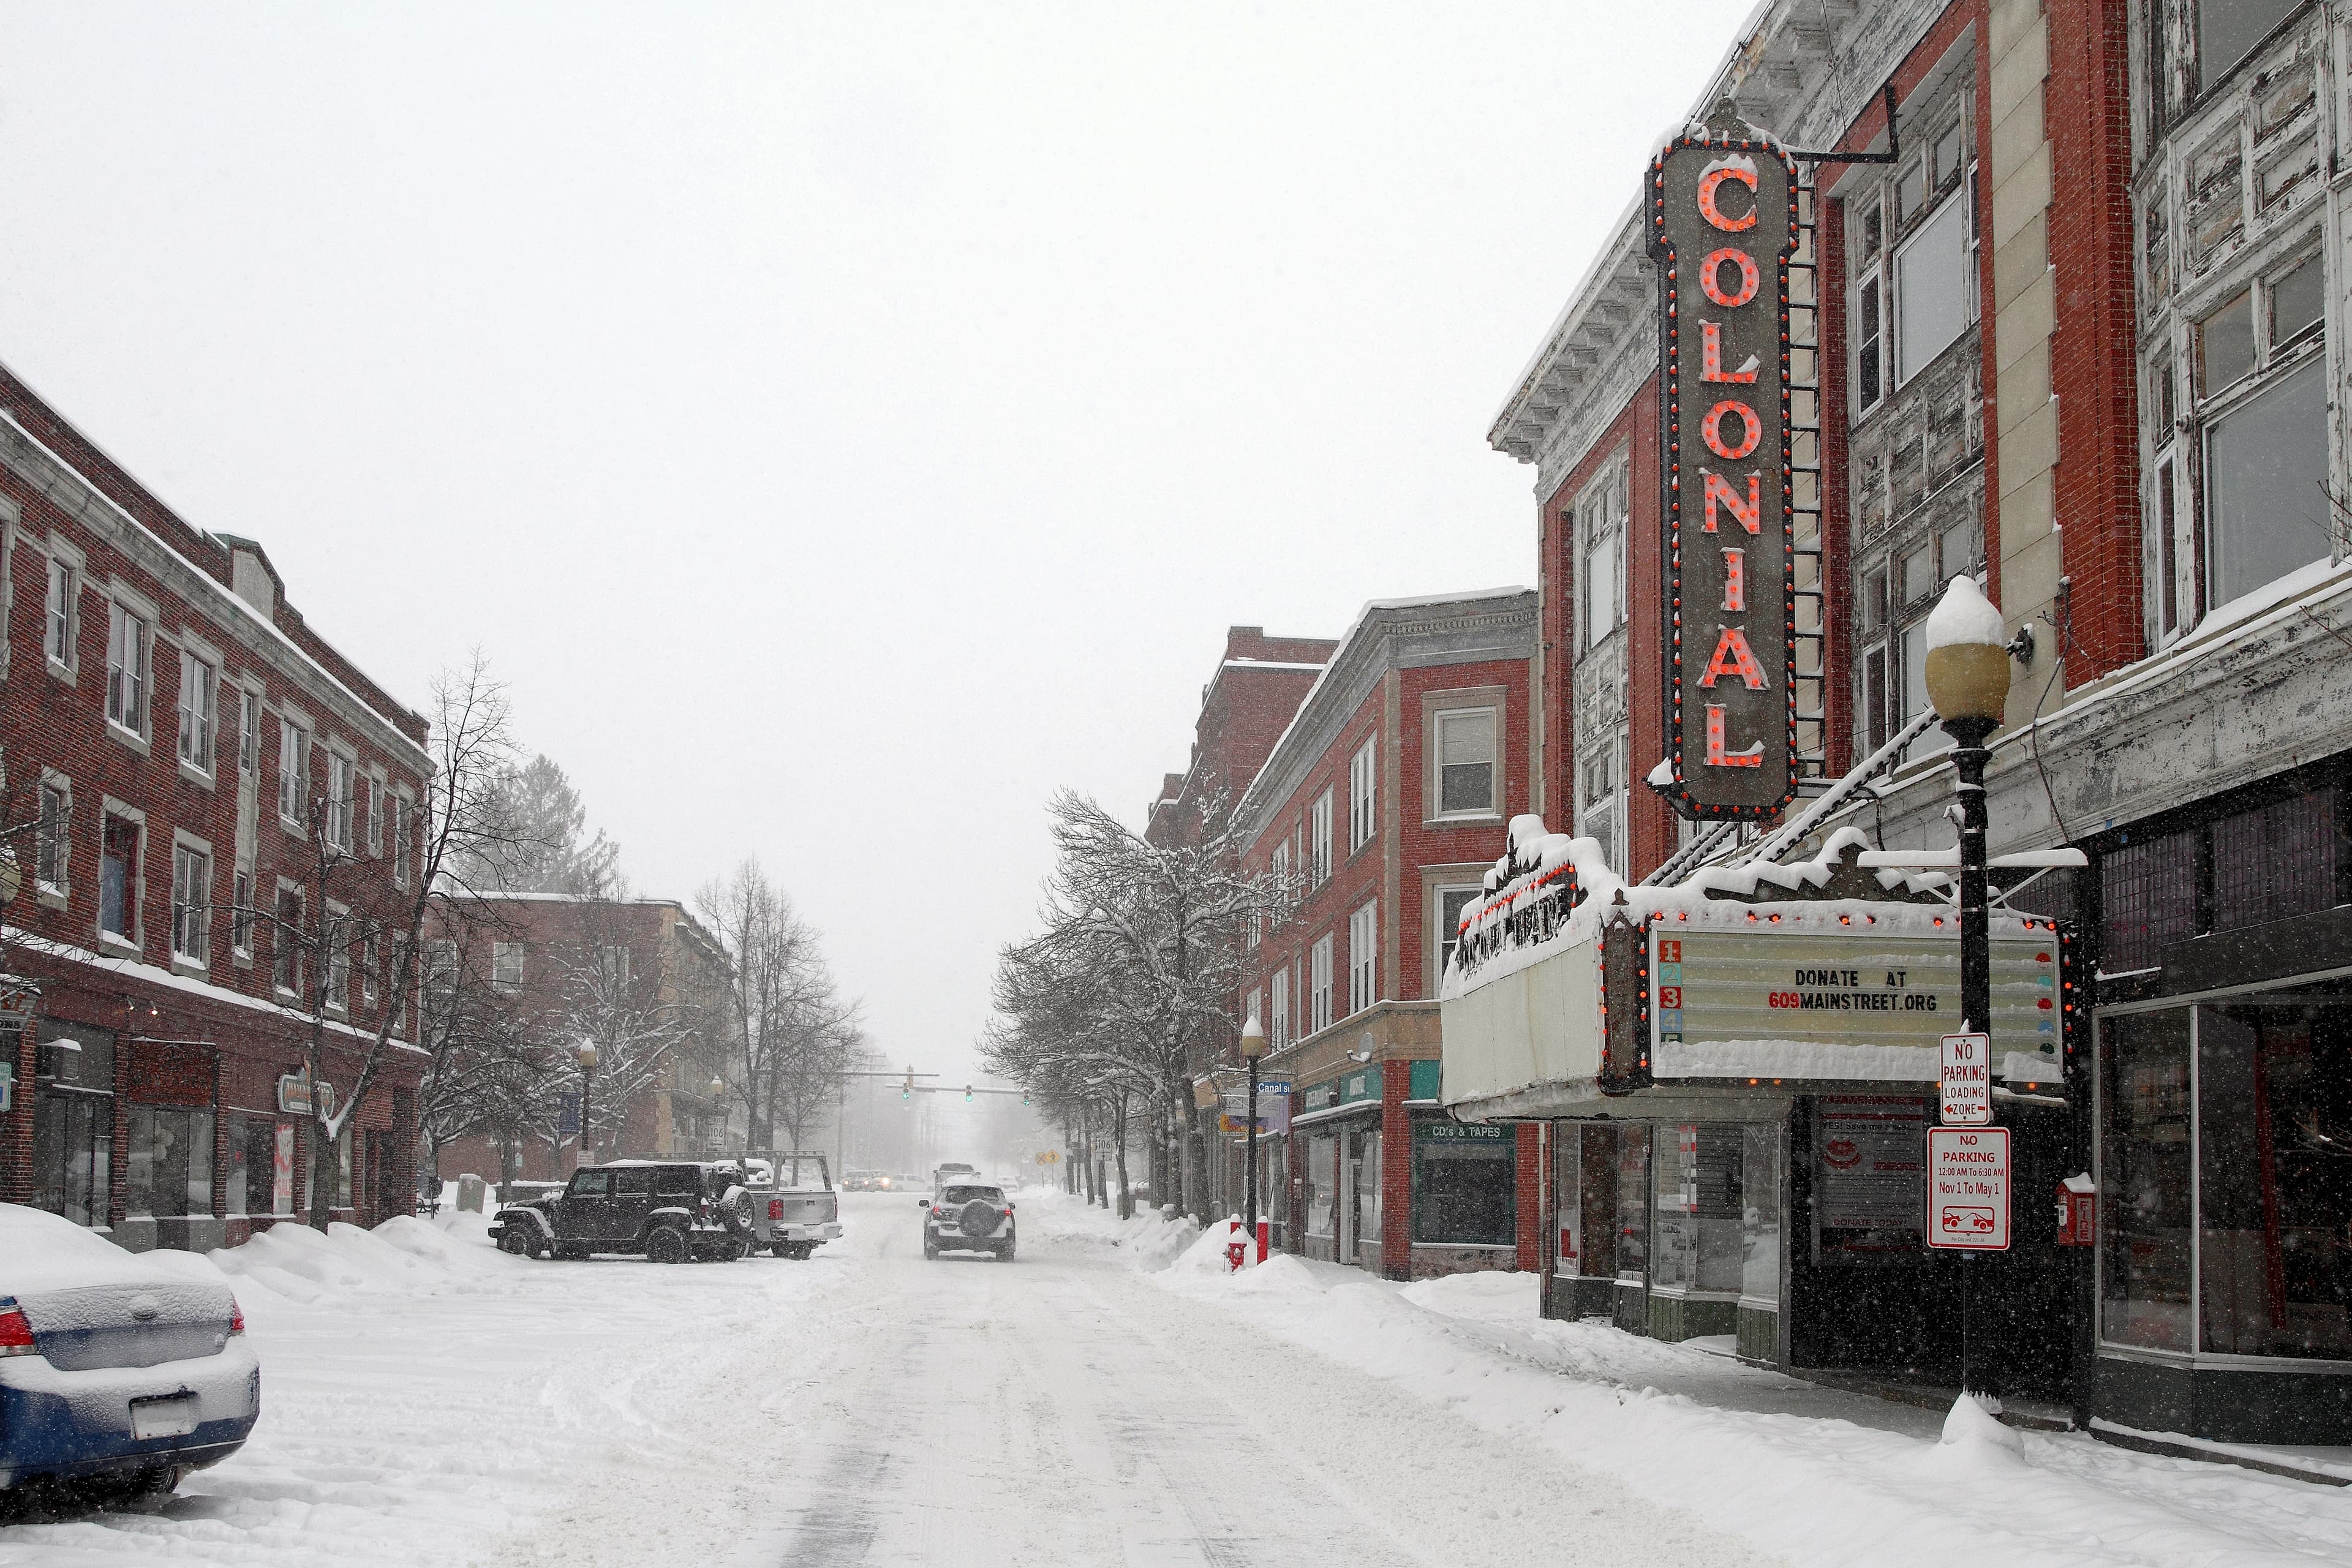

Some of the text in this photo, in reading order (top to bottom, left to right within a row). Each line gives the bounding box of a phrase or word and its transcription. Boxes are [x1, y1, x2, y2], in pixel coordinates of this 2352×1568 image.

[1697, 160, 1770, 767] COLONIAL
[1664, 942, 1677, 961] 1
[1662, 964, 1679, 982] 2
[1795, 970, 1906, 987] DONATE AT
[1663, 987, 1678, 1008] 3
[1768, 992, 1937, 1011] 609MAINSTREET.ORG
[1662, 1011, 1679, 1030] 4
[1955, 1043, 1973, 1060] NO
[1944, 1065, 1985, 1082] PARKING
[1258, 1083, 1281, 1092] Canal
[1945, 1087, 1984, 1098] LOADING
[1953, 1104, 1977, 1115] ZONE
[1433, 1126, 1501, 1137] CD's & TAPES
[1846, 1121, 1866, 1130] Save
[1098, 1140, 1110, 1149] 106
[1960, 1135, 1978, 1145] NO
[1943, 1152, 1995, 1162] PARKING
[1939, 1167, 1955, 1176] 12:00
[1939, 1182, 1999, 1198] Nov 1 To May 1
